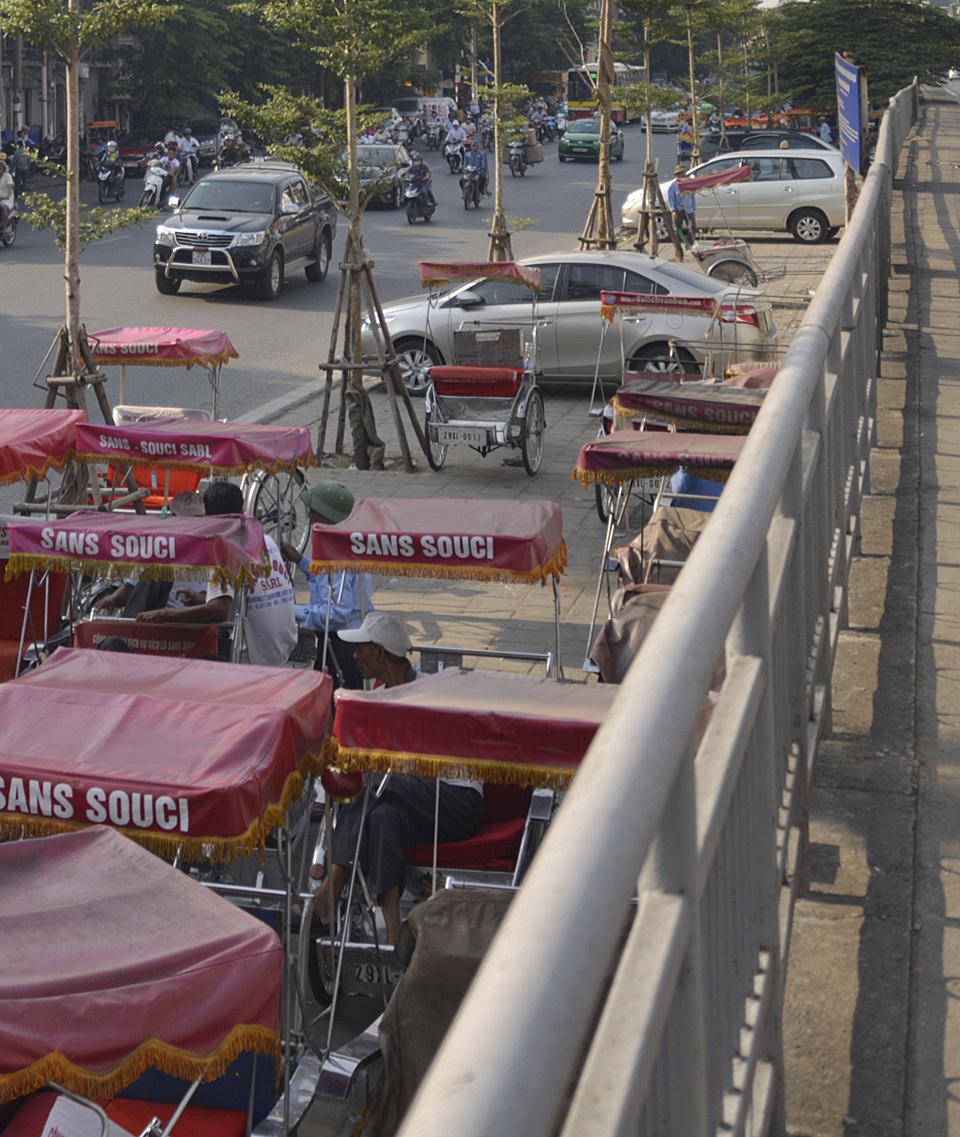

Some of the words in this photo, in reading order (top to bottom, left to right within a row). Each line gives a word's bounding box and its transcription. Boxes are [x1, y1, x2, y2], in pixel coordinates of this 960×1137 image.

[120, 342, 159, 354] SOUCI
[100, 435, 131, 451] SANS
[140, 441, 177, 456] SOUCI
[180, 444, 212, 459] SARL
[40, 527, 99, 555] SANS
[110, 535, 176, 559] SOUCI
[350, 532, 415, 557] SANS
[420, 535, 494, 560] SOUCI
[260, 577, 283, 591] SARL
[86, 787, 189, 833] SOUCI
